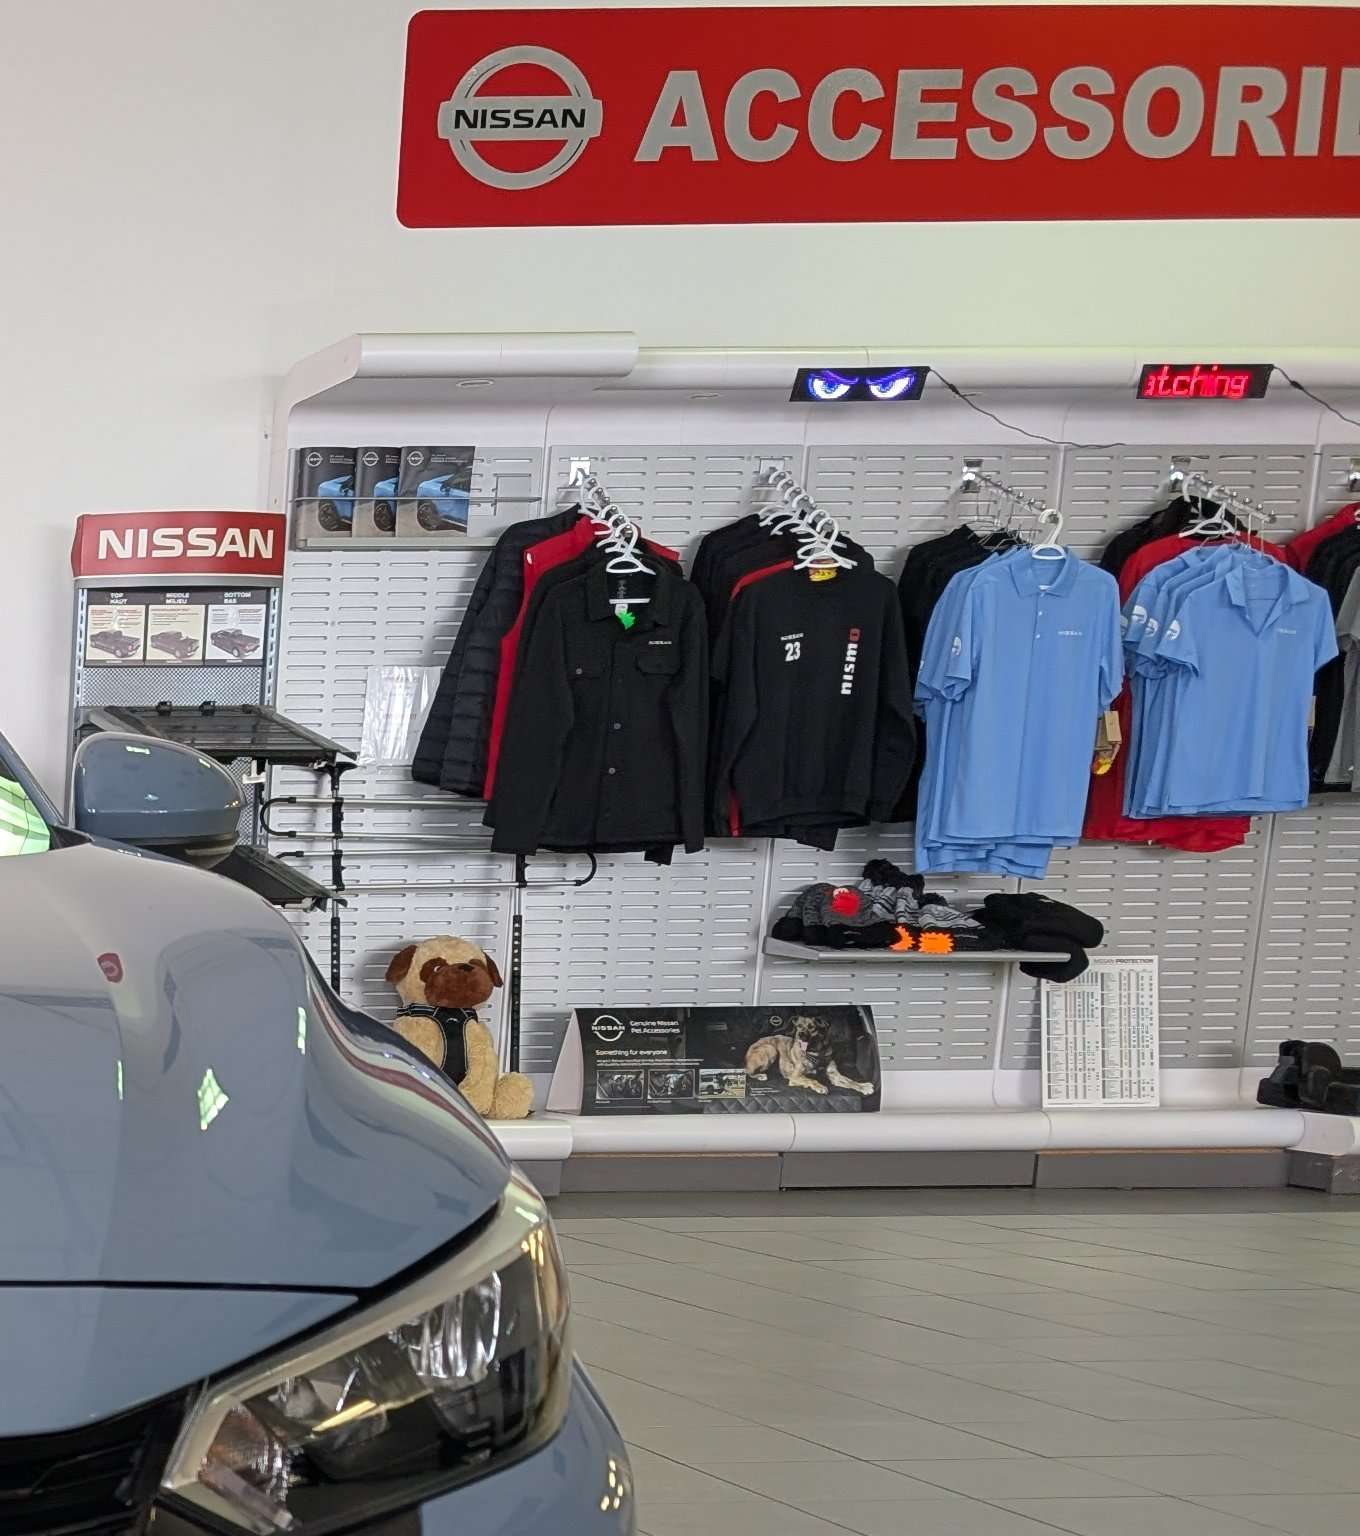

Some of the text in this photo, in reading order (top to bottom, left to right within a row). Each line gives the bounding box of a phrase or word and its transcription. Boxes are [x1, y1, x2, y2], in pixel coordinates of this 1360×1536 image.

[454, 108, 586, 130] NISSAN
[97, 527, 274, 560] NISSAN
[784, 641, 801, 662] 23
